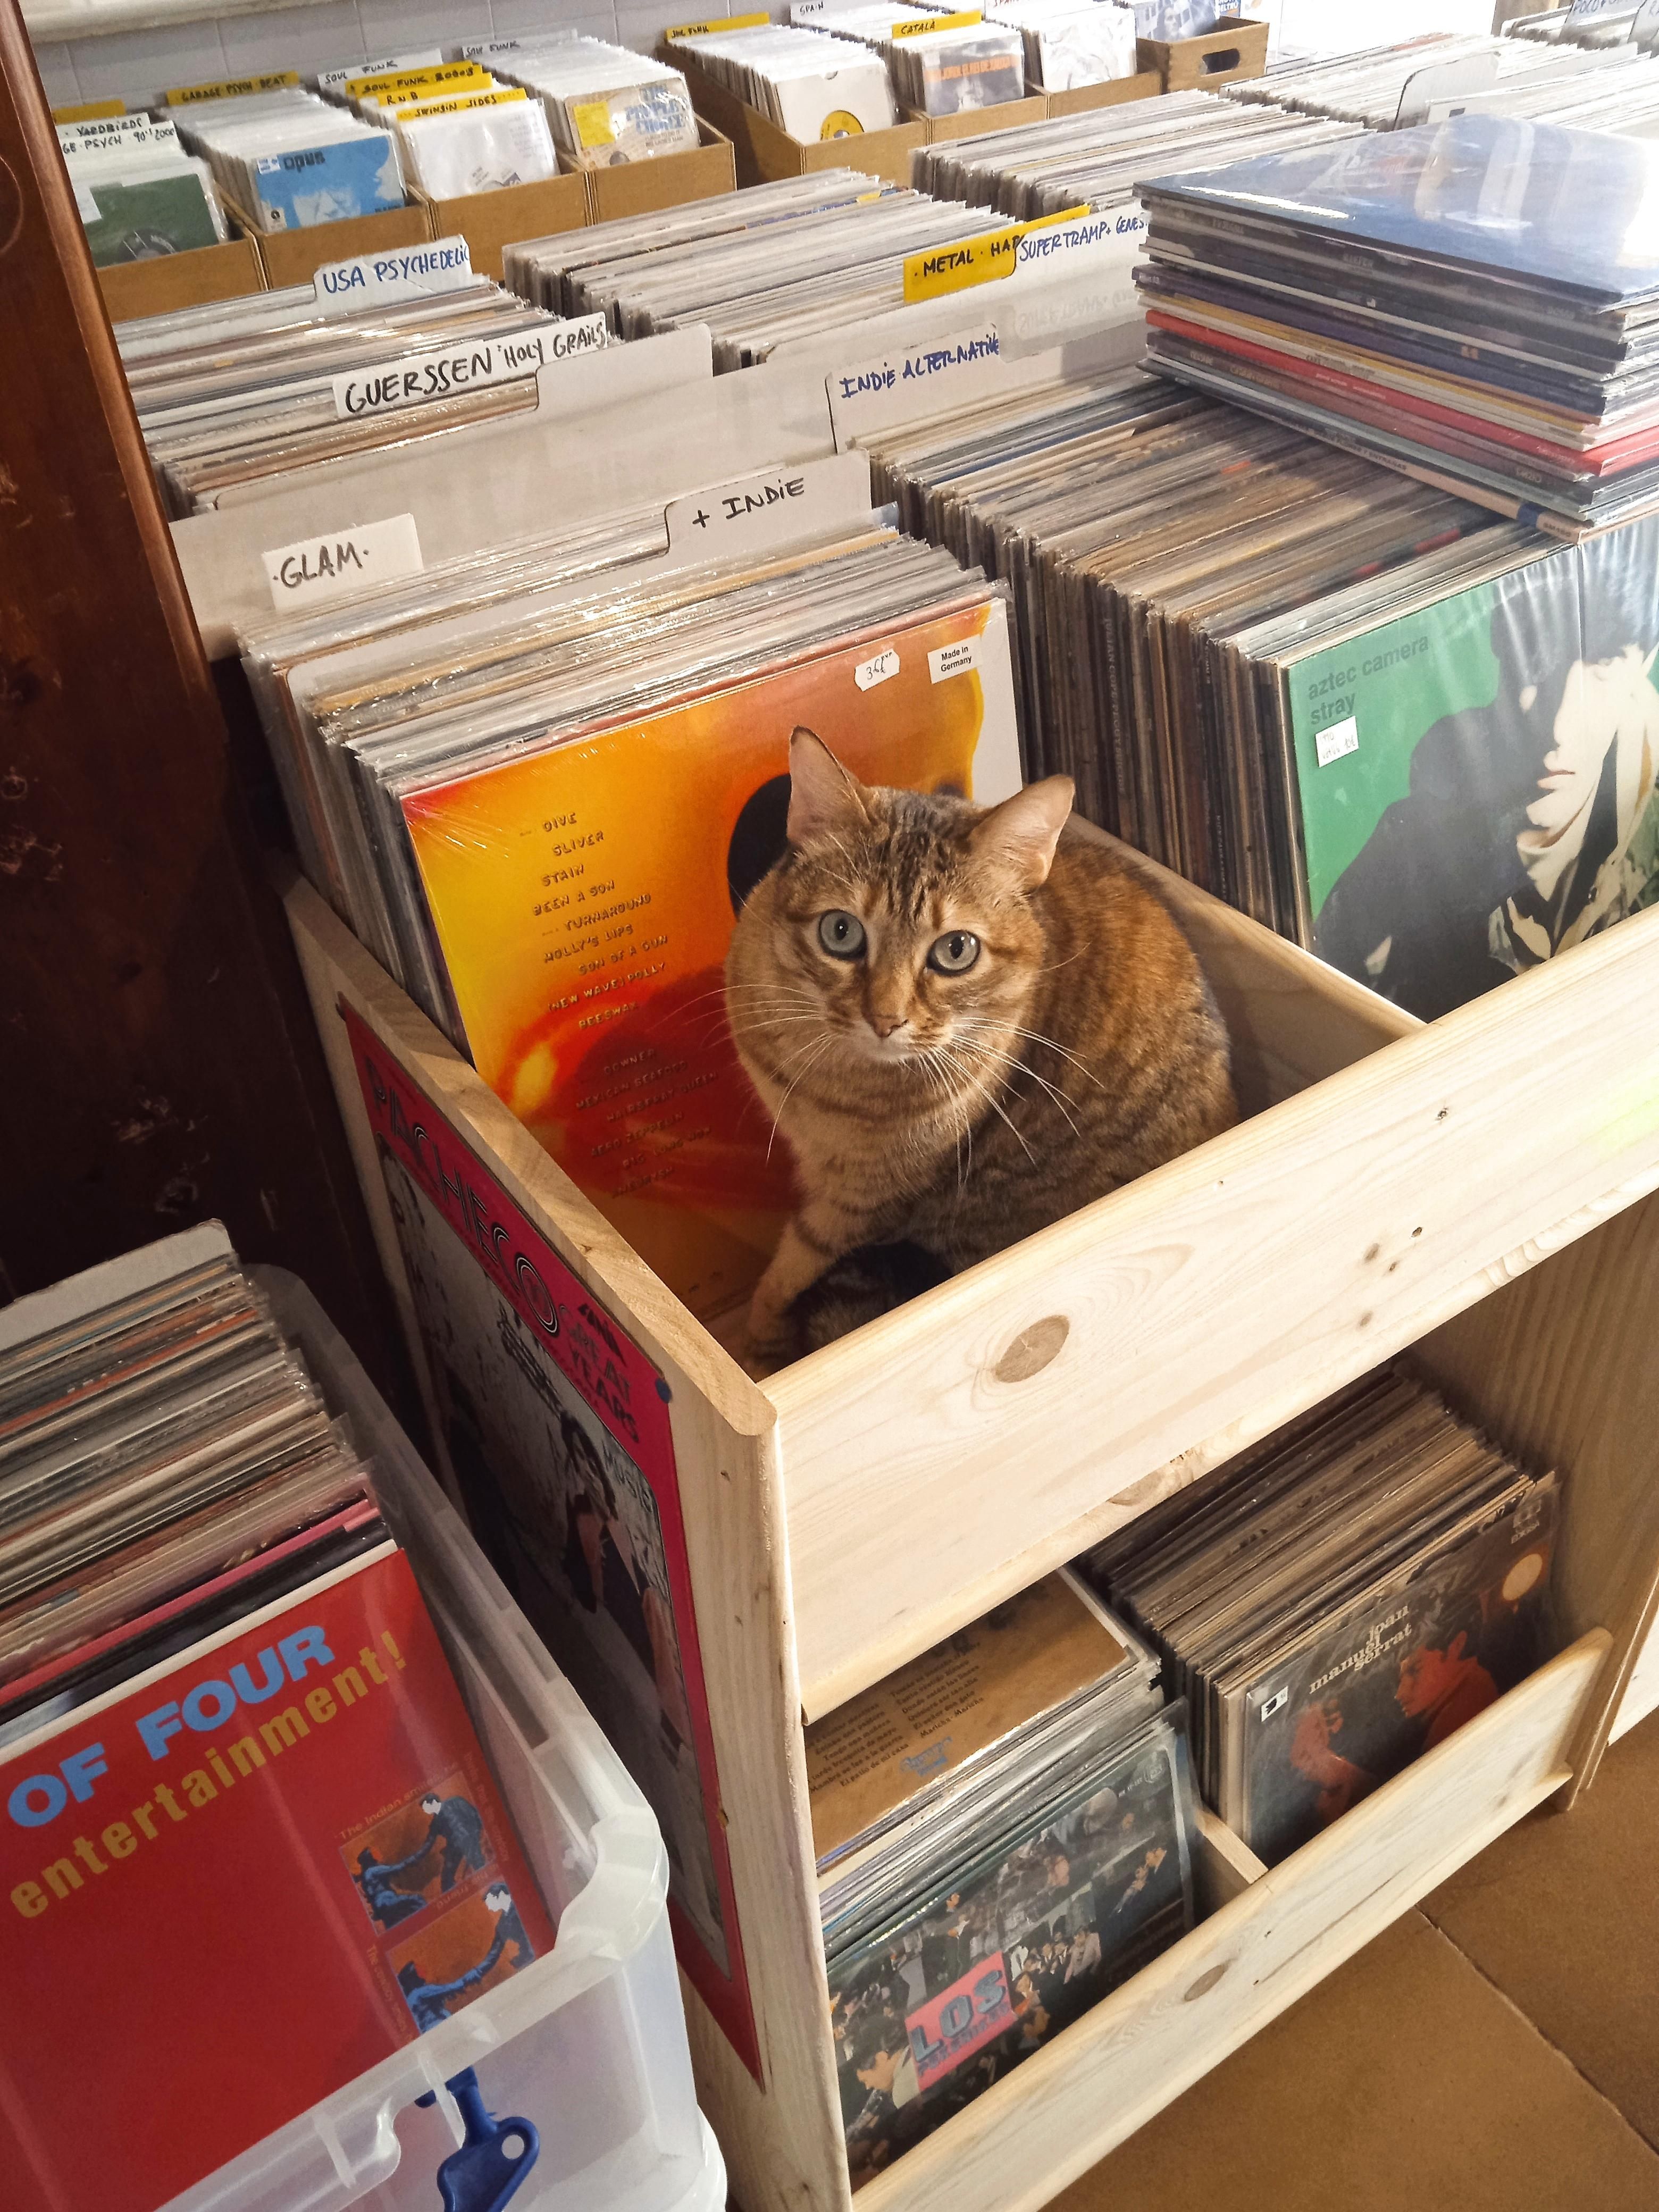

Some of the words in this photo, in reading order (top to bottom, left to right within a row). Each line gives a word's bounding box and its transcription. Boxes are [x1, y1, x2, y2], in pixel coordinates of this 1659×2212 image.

[325, 71, 348, 85] SOUL
[362, 60, 398, 74] FUNK
[397, 76, 429, 88] FUNK
[387, 95, 396, 105] R
[398, 96, 406, 105] N
[410, 91, 418, 101] B
[84, 135, 122, 150] PSYCH
[322, 266, 366, 294] USA
[924, 248, 974, 278] METAL
[345, 347, 492, 414] GUERSSEN
[692, 509, 710, 528] +
[940, 655, 973, 673] Germany
[941, 649, 960, 661] Made
[960, 645, 969, 655] in
[1308, 666, 1358, 701] aztec
[1361, 635, 1430, 677] camera
[1310, 693, 1356, 725] stray
[551, 830, 605, 857] SLIVER
[540, 862, 585, 887] STAIN
[533, 894, 571, 917] BEEN
[576, 891, 586, 903] A
[590, 879, 616, 898] SON
[563, 892, 652, 932] TURNAROUND
[543, 935, 600, 963] MOLLY'S
[604, 923, 634, 942] LIPS
[578, 957, 606, 976] SON
[609, 949, 625, 963] OF
[630, 945, 637, 956] A
[641, 934, 668, 952] GUN
[627, 961, 666, 982] POLLY
[578, 1001, 639, 1030] BEESWAX
[575, 1082, 630, 1111] MEXICAN
[634, 1060, 689, 1087] SEAFOOD
[607, 1088, 675, 1121] HAIRSPRAY
[680, 1070, 718, 1094] QUEEN
[590, 1137, 622, 1158] AERO
[626, 1111, 684, 1144] ZEPPELIN
[365, 1054, 559, 1340] PACHECO
[1369, 1605, 1409, 1644] joan
[1309, 1630, 1382, 1695] manuel
[1354, 1622, 1412, 1672] serrat
[7, 1741, 109, 1828] OF
[135, 1625, 336, 1762] FOUR
[824, 1745, 847, 1761] Tengo
[848, 1736, 862, 1747] una
[850, 1767, 869, 1782] patio
[893, 1744, 909, 1756] casa
[9, 1630, 408, 1920] entertainment!
[340, 1824, 364, 1842] The
[364, 1799, 401, 1824] Indian
[910, 1968, 1008, 2064] LOS
